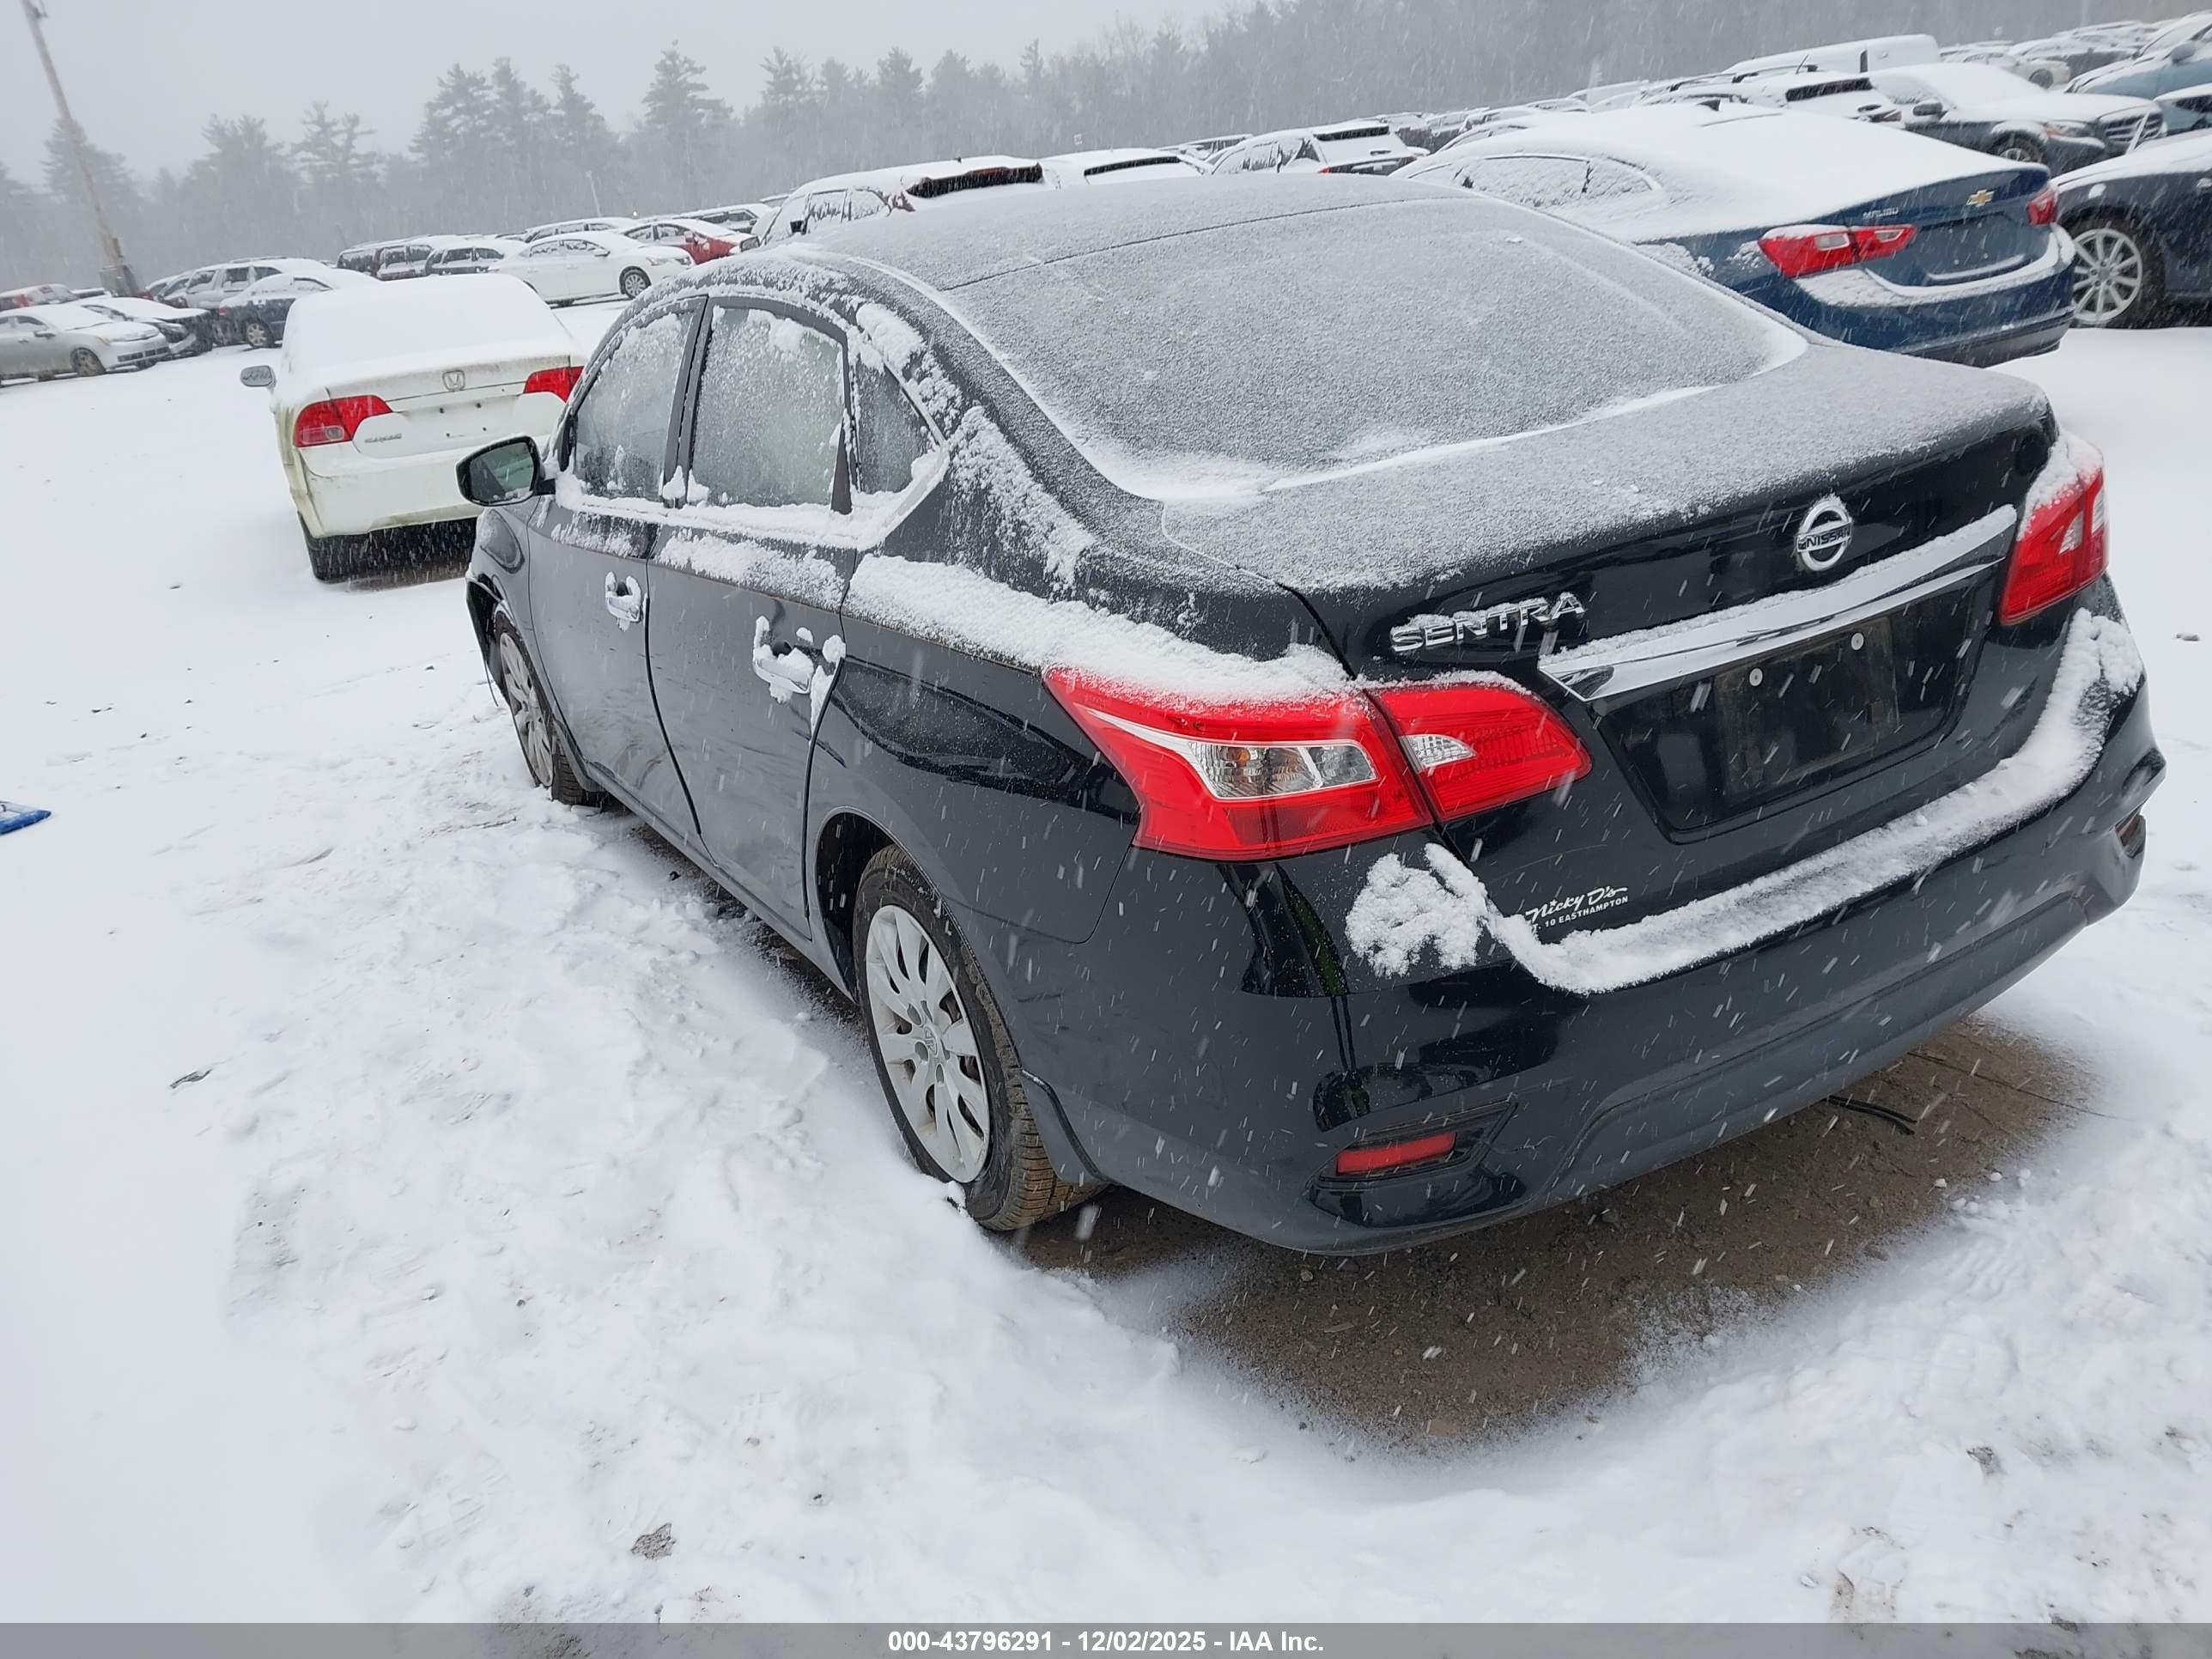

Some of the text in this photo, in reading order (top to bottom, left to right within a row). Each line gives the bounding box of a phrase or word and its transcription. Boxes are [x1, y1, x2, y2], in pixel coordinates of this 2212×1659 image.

[1389, 593, 1585, 653] SENTRA
[1525, 885, 1628, 923] Nicky D's
[1545, 918, 1556, 929] 10
[1559, 896, 1629, 924] EASTHAMPTON
